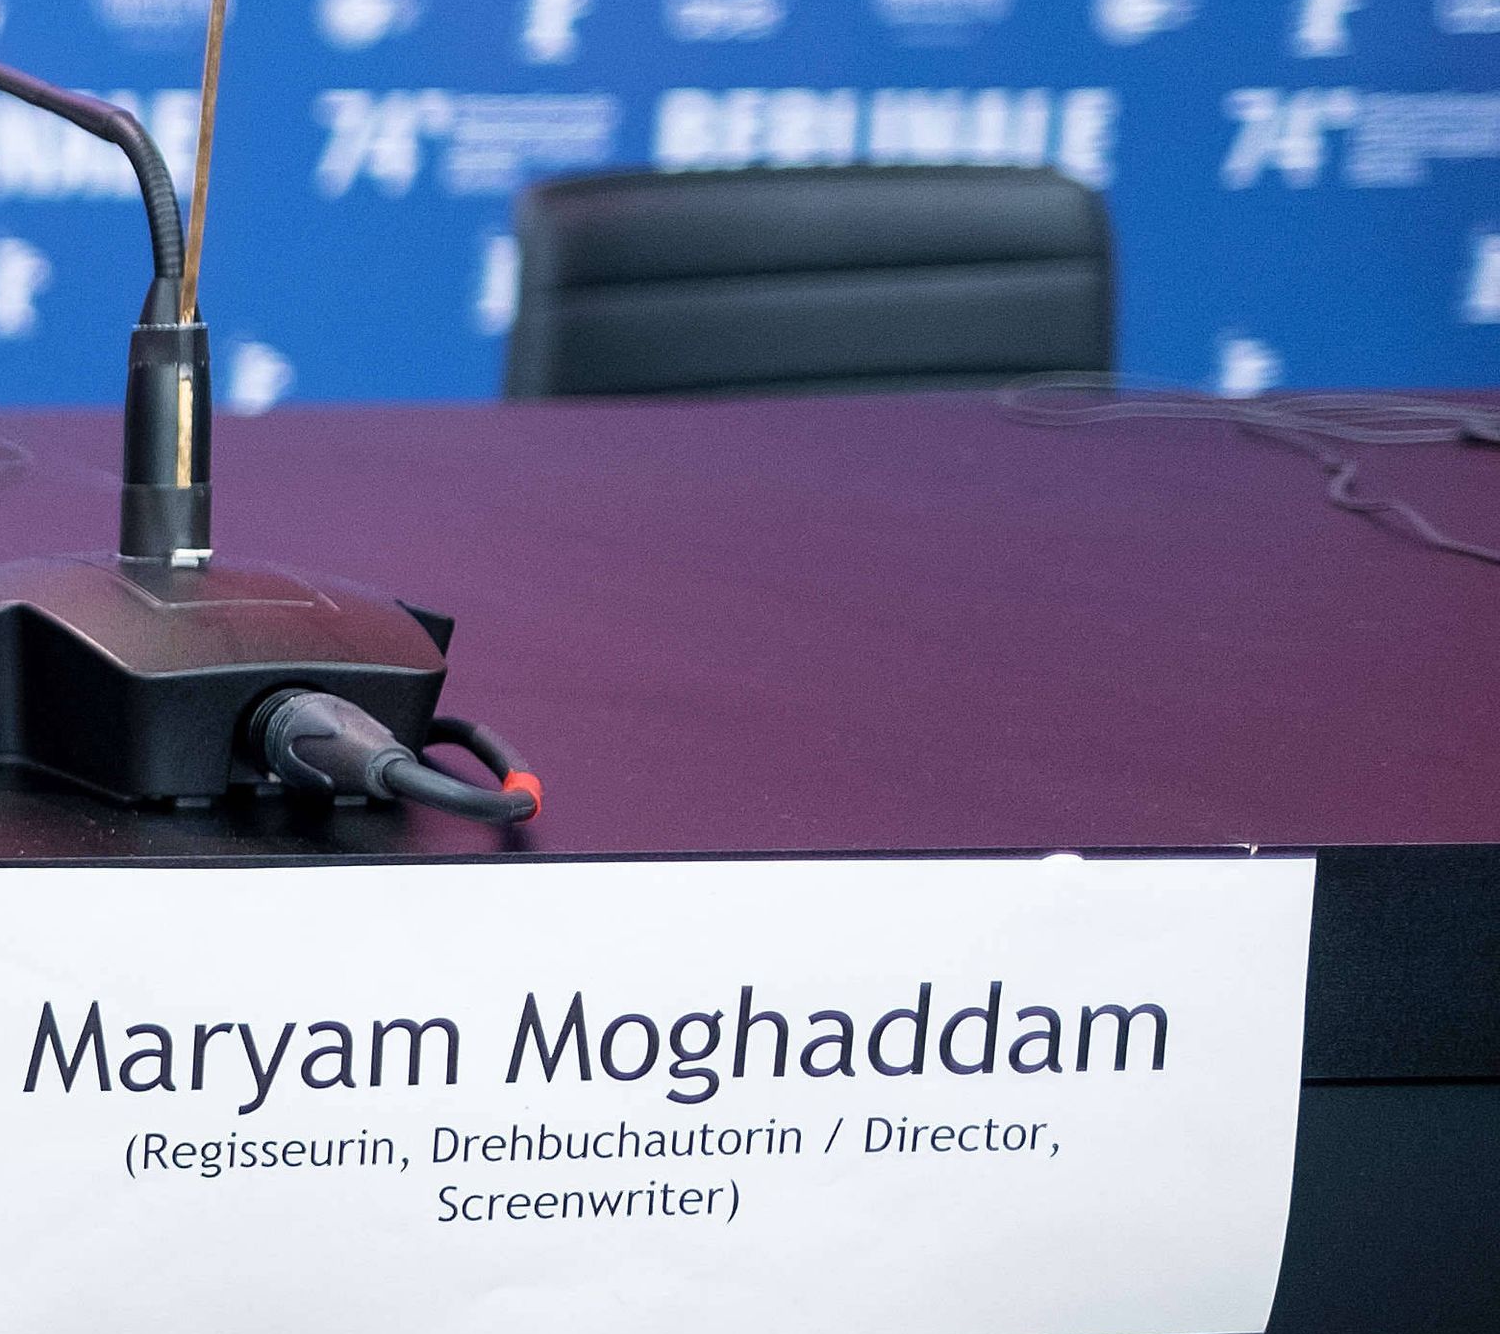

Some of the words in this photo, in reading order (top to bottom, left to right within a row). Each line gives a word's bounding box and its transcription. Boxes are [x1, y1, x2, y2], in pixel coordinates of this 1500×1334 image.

[21, 1000, 460, 1115] Maryam
[504, 980, 1169, 1103] Moghaddam
[124, 1129, 411, 1179] (Regisseurin,
[431, 1117, 803, 1164] Drehbuchautorin
[823, 1117, 845, 1154] /
[863, 1115, 1060, 1159] Director,
[437, 1177, 740, 1224] Screenwriter)
